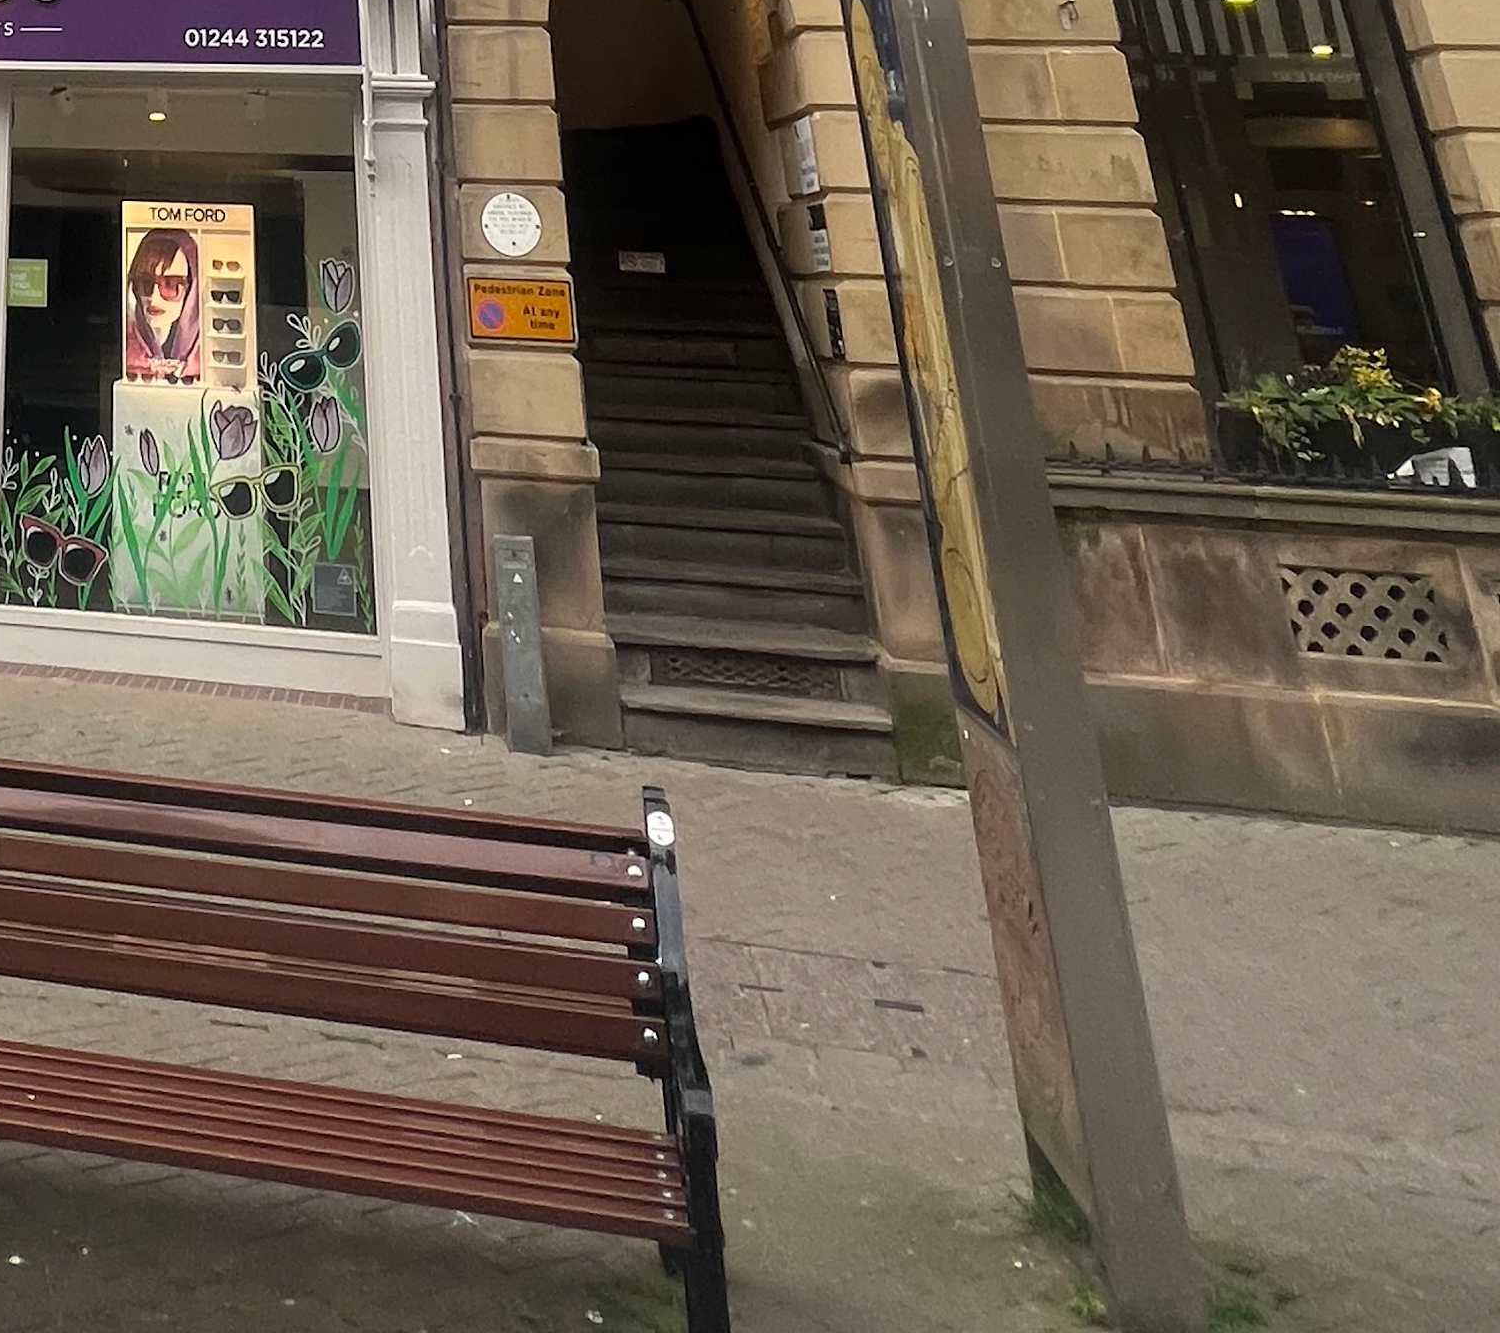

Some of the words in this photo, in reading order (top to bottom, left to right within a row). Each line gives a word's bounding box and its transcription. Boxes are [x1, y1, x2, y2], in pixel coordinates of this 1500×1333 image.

[184, 28, 249, 47] 01244
[255, 29, 325, 48] 315122
[149, 207, 182, 222] TOM
[185, 208, 226, 223] FORD
[474, 284, 534, 295] Pedestrian
[538, 285, 566, 297] Zone
[522, 303, 536, 316] At
